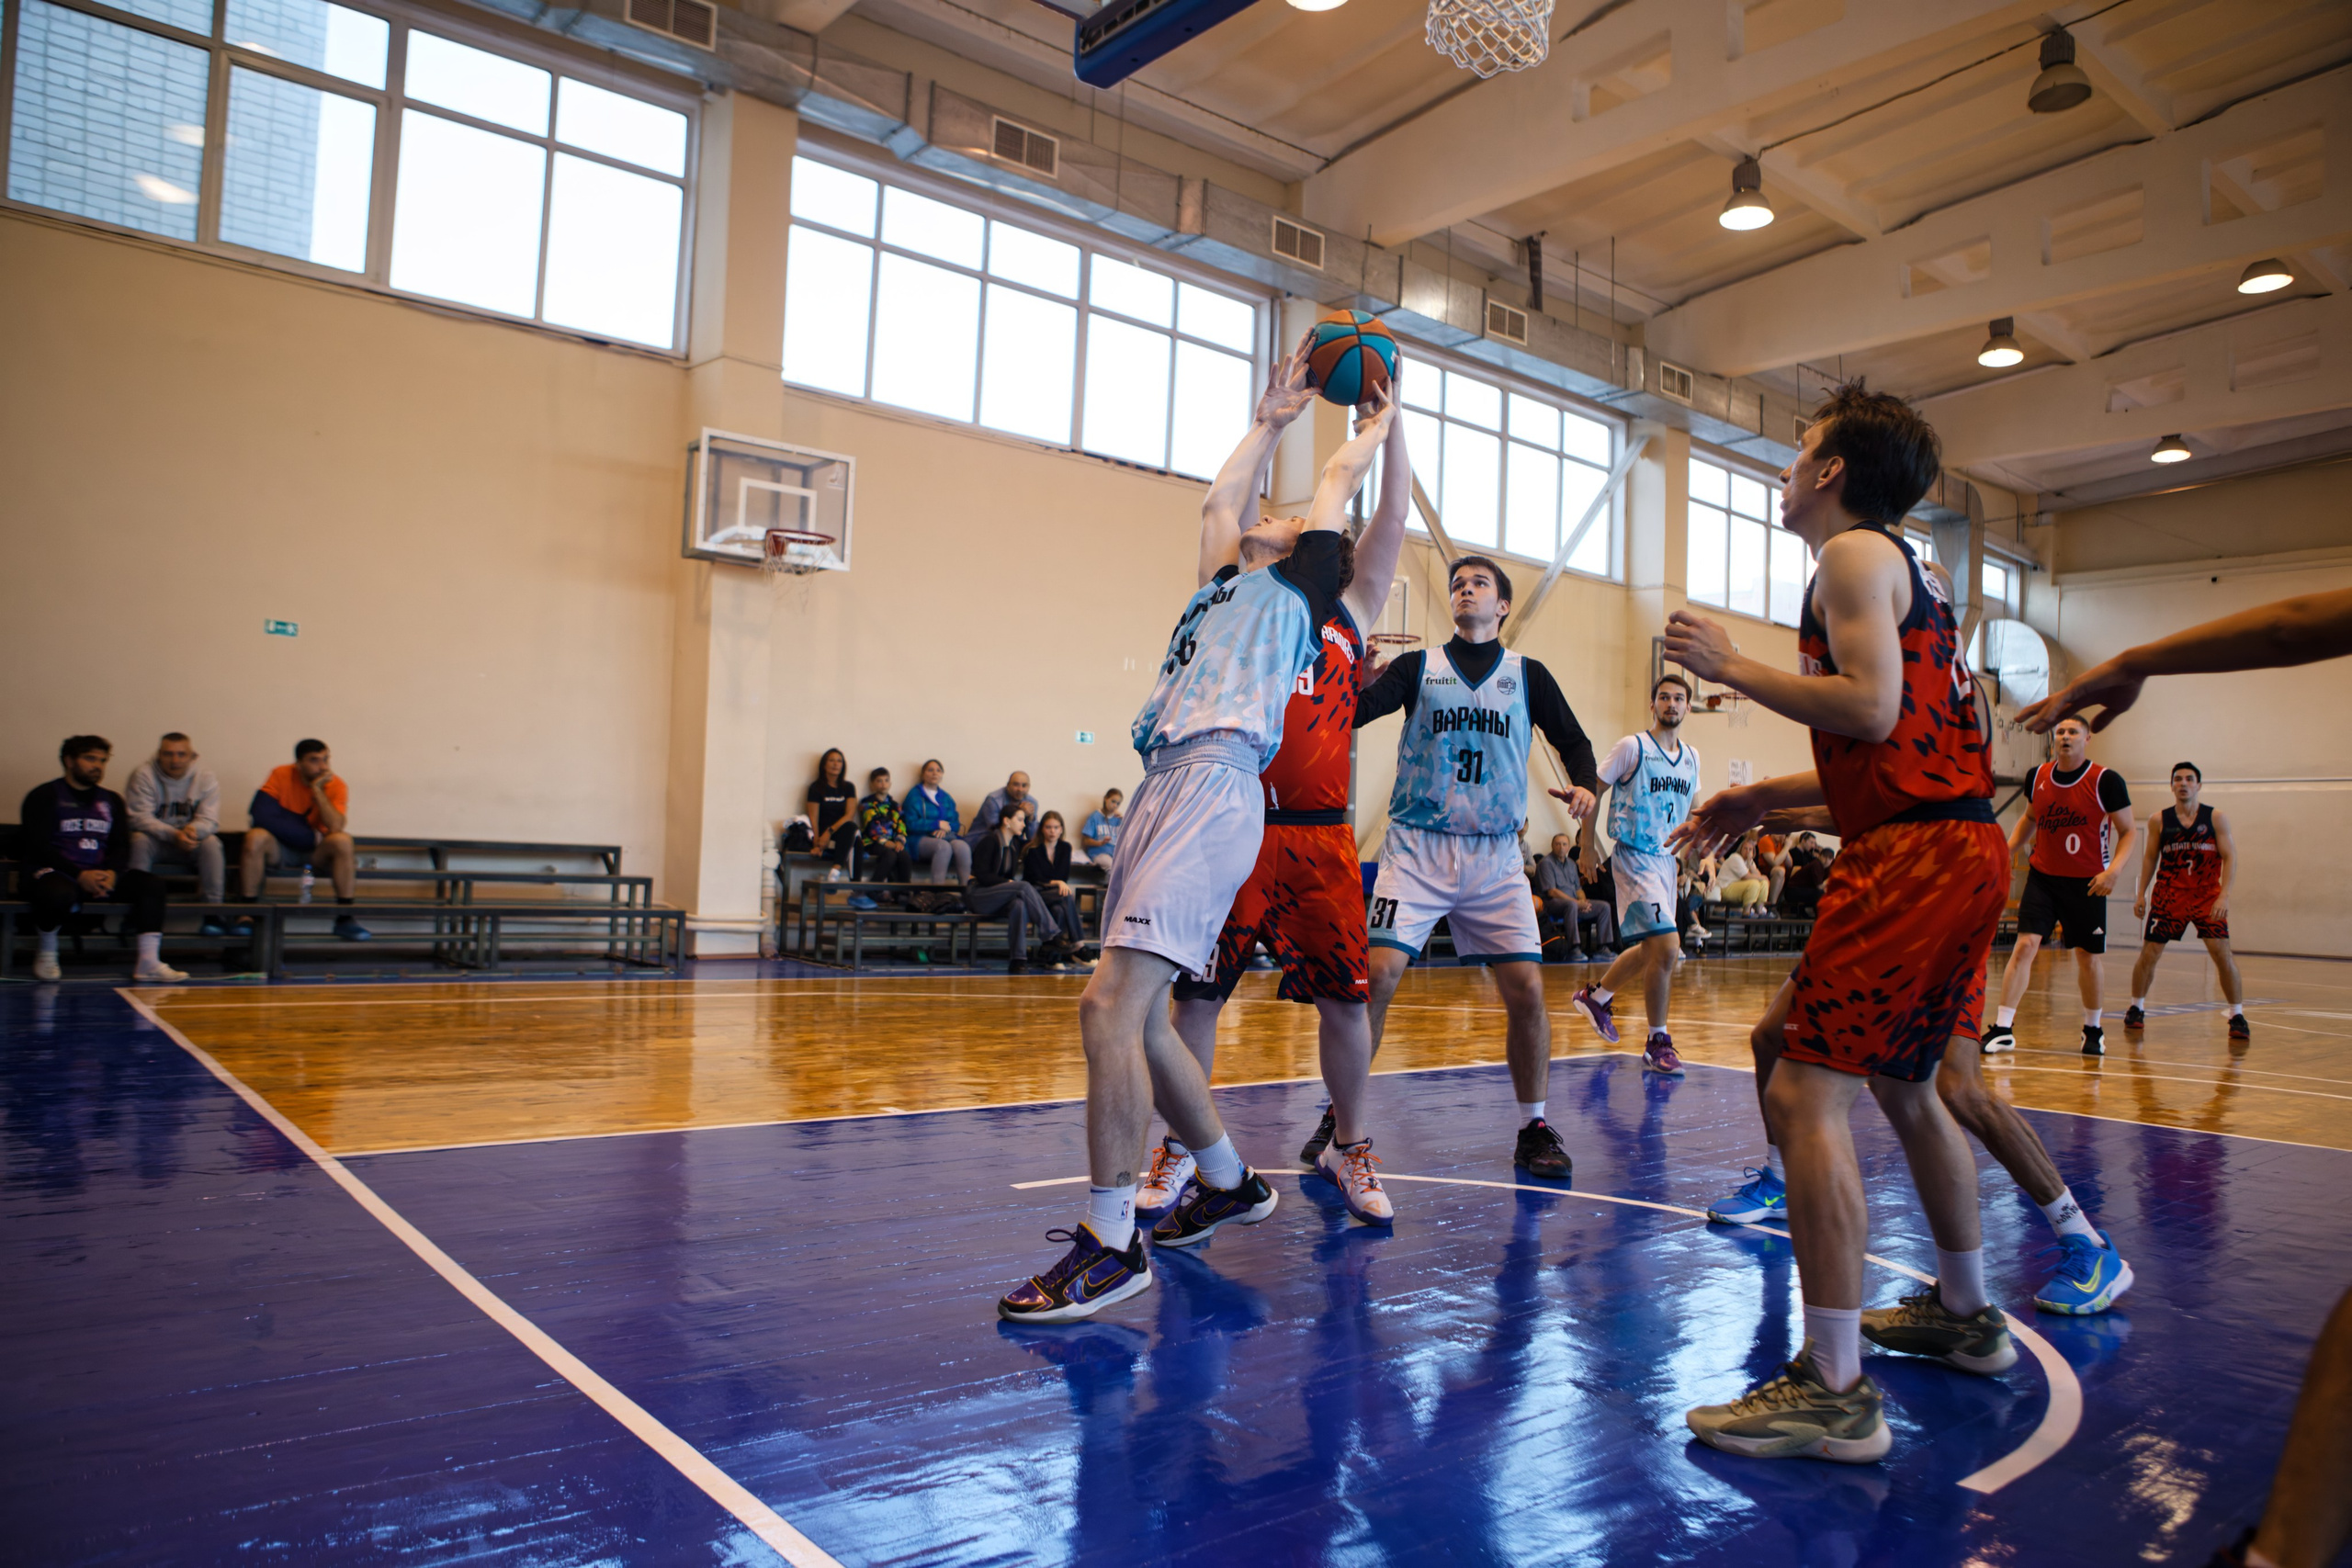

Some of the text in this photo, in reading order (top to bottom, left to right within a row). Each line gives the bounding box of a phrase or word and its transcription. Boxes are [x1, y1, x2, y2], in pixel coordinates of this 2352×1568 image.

[1425, 676, 1457, 685] fruitit
[1432, 706, 1510, 739] ВАРАНЫ
[1456, 749, 1484, 784] 31
[1650, 775, 1691, 797] ВАРАНЫ
[1667, 802, 1674, 824] 7
[2047, 800, 2070, 818] Los
[2037, 810, 2088, 834] Angeles
[2064, 832, 2081, 855] 0
[2185, 860, 2193, 876] 7
[1124, 916, 1151, 926] MAXX
[1370, 897, 1398, 930] 31
[1651, 902, 1661, 924] 7
[2150, 919, 2159, 934] 7
